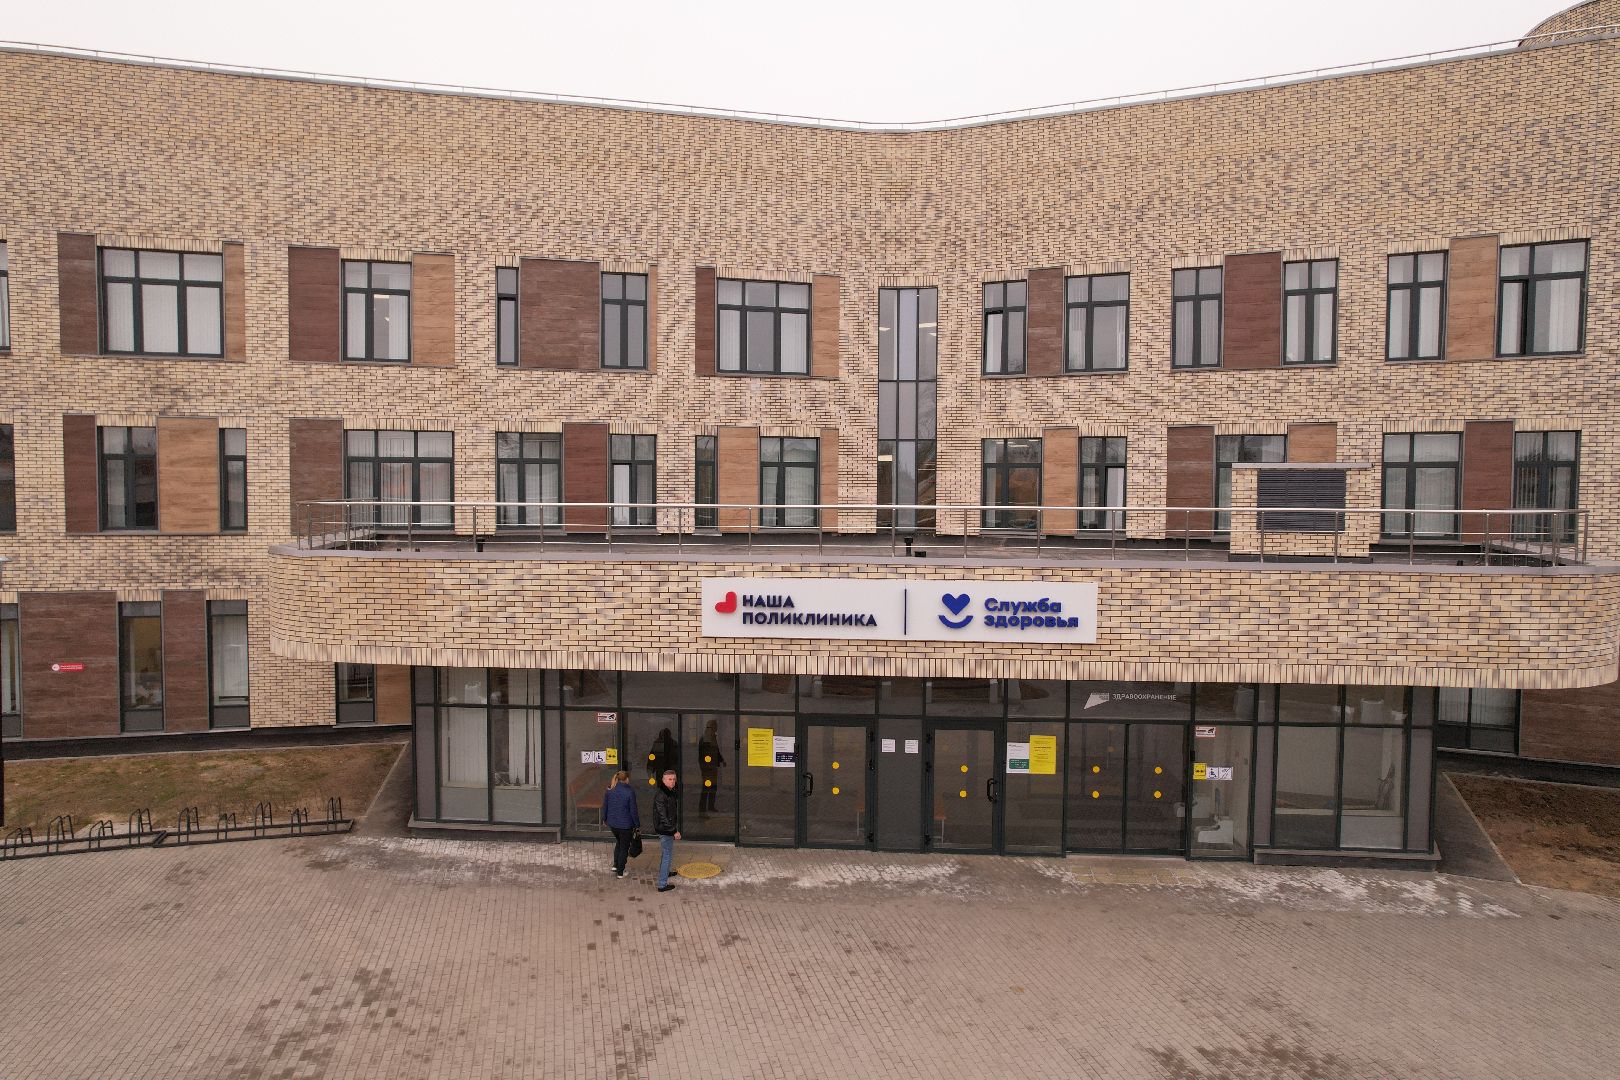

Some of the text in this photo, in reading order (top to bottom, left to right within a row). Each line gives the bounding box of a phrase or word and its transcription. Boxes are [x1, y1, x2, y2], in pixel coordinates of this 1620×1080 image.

[742, 594, 795, 608] НАША
[984, 597, 1062, 615] Служба
[742, 611, 878, 627] ПОЛИКЛИНИКА
[984, 614, 1079, 630] здоровья
